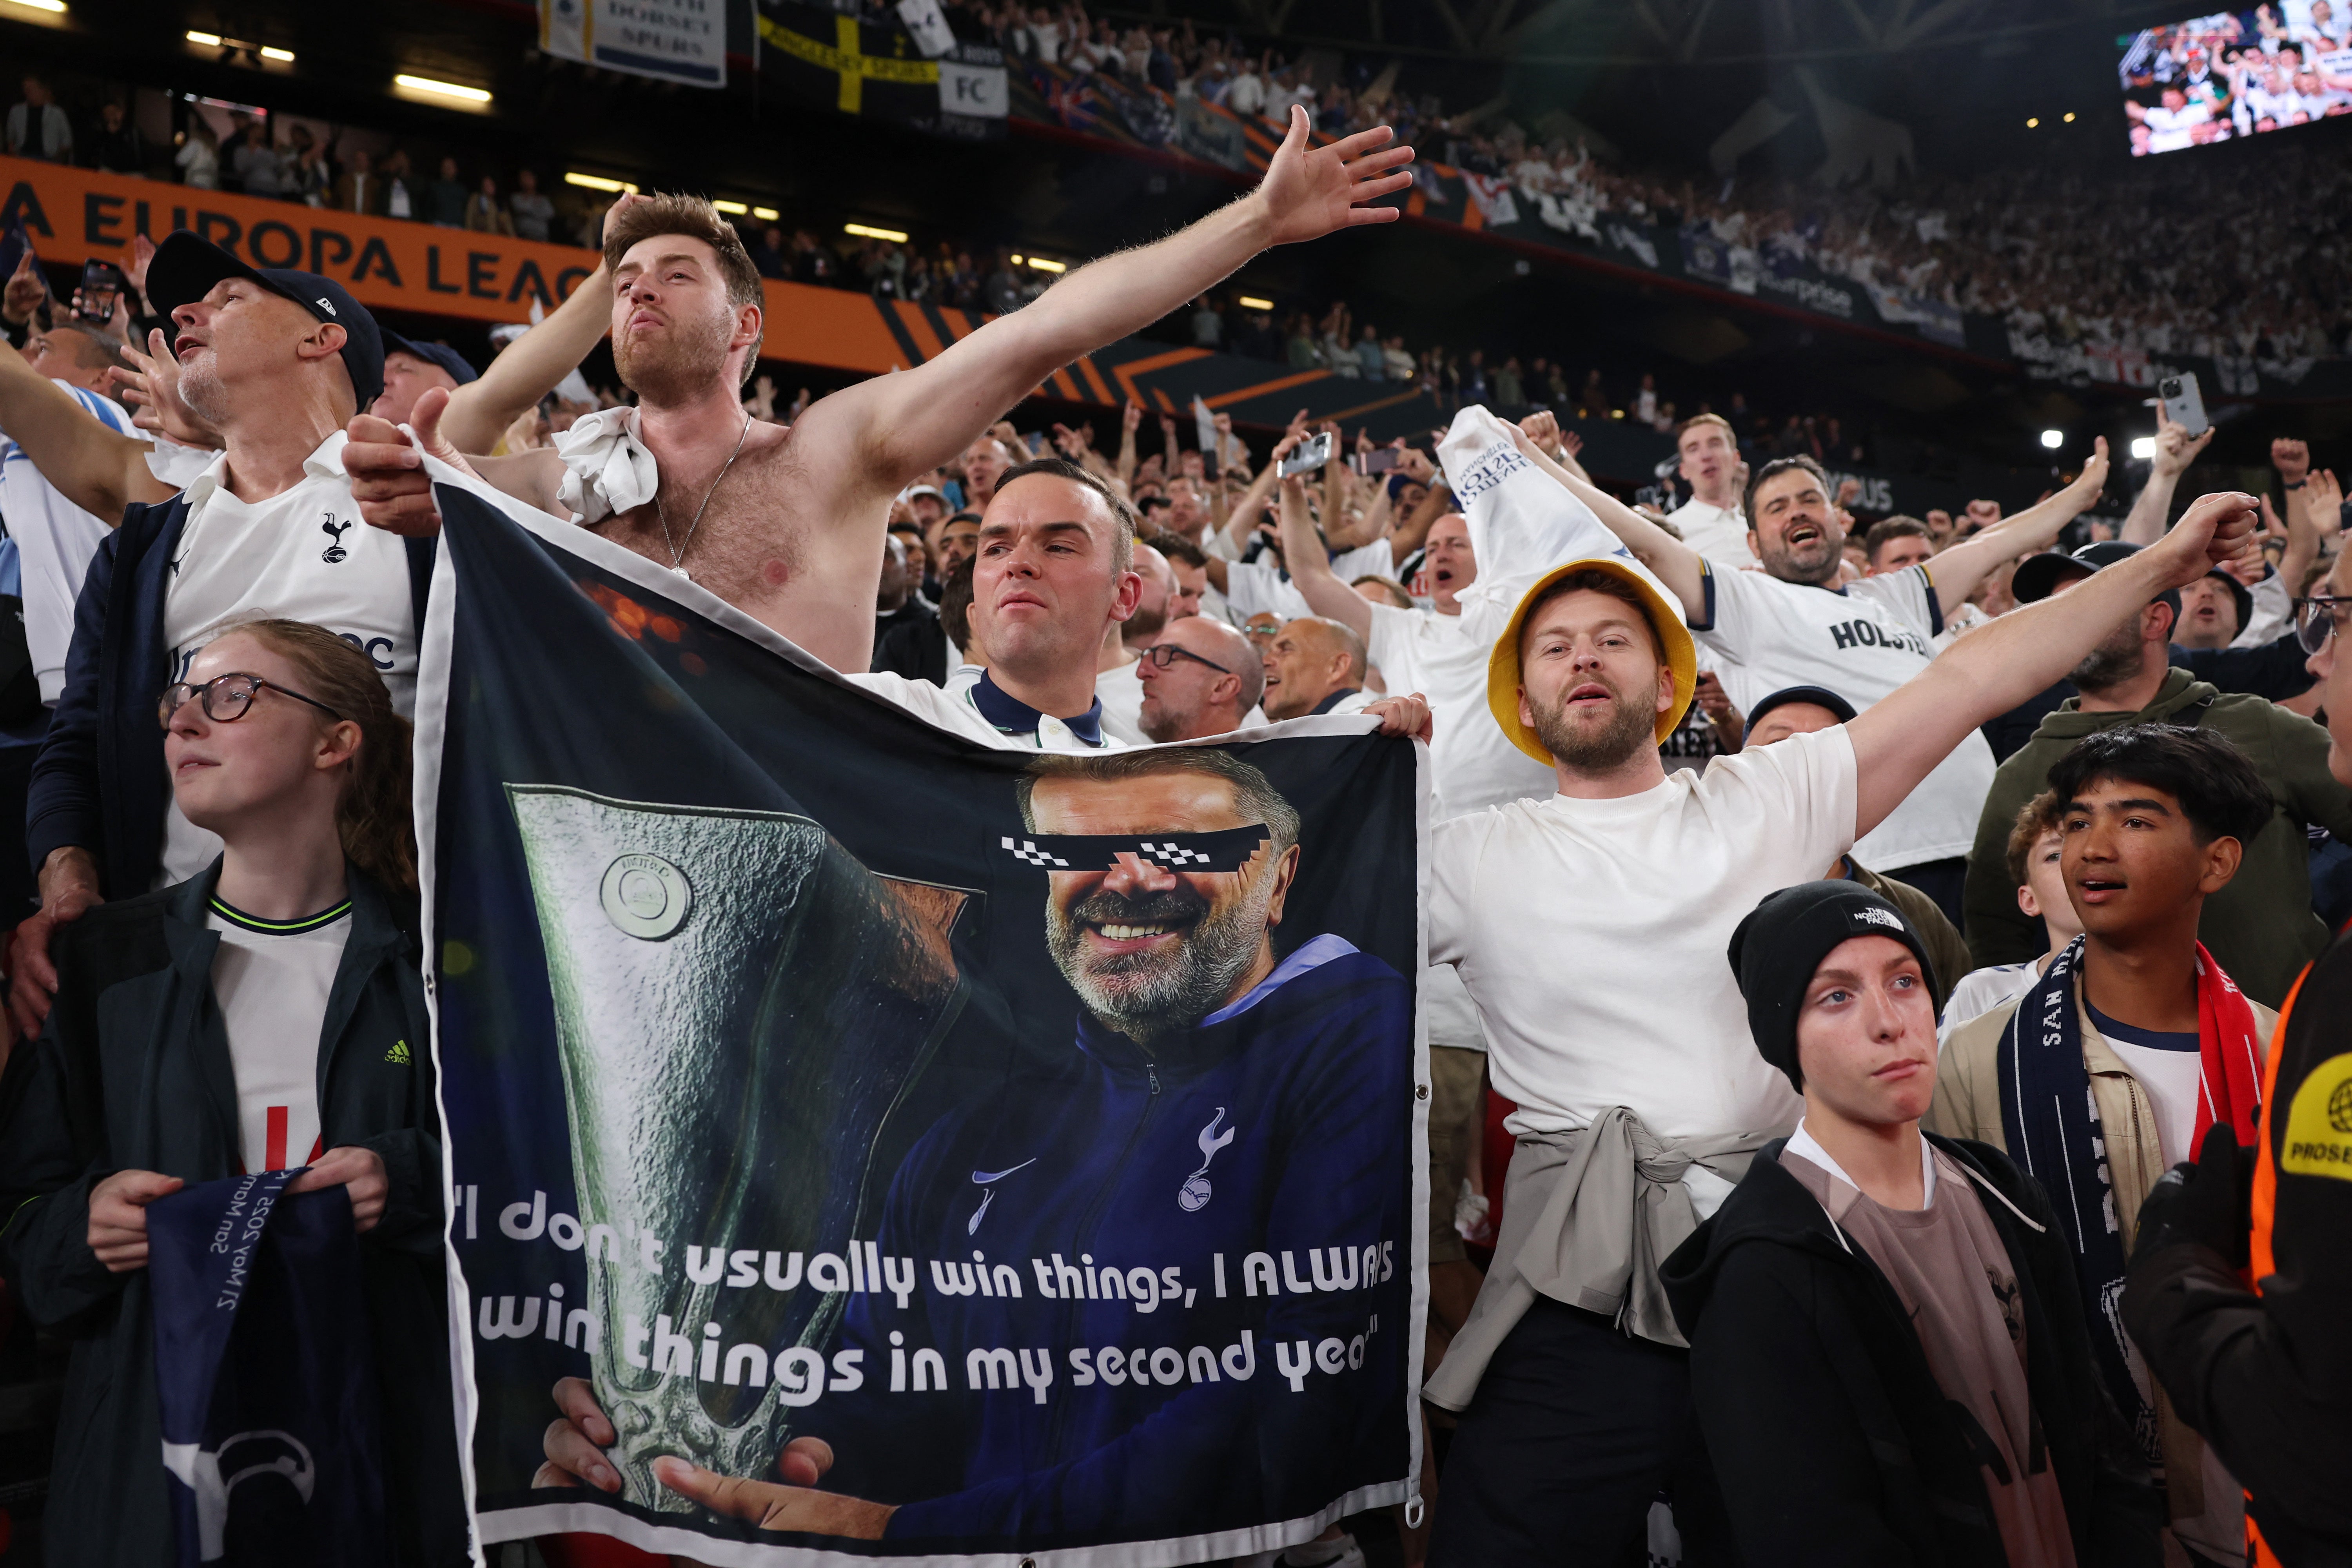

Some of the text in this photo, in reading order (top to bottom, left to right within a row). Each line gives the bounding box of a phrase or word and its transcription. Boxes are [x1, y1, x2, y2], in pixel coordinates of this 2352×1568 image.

[956, 77, 985, 104] FC
[428, 246, 593, 307] LEA
[385, 1054, 411, 1066] adida
[499, 1189, 663, 1275] don't
[685, 1240, 915, 1308] usually
[930, 1250, 1022, 1298] win
[1031, 1253, 1198, 1314] things,
[1214, 1253, 1227, 1298] I
[1243, 1240, 1393, 1297] ALWAYS
[478, 1282, 599, 1354] win
[623, 1312, 864, 1407] things
[889, 1330, 947, 1391] in
[966, 1347, 1054, 1405] my
[1070, 1329, 1255, 1386] second
